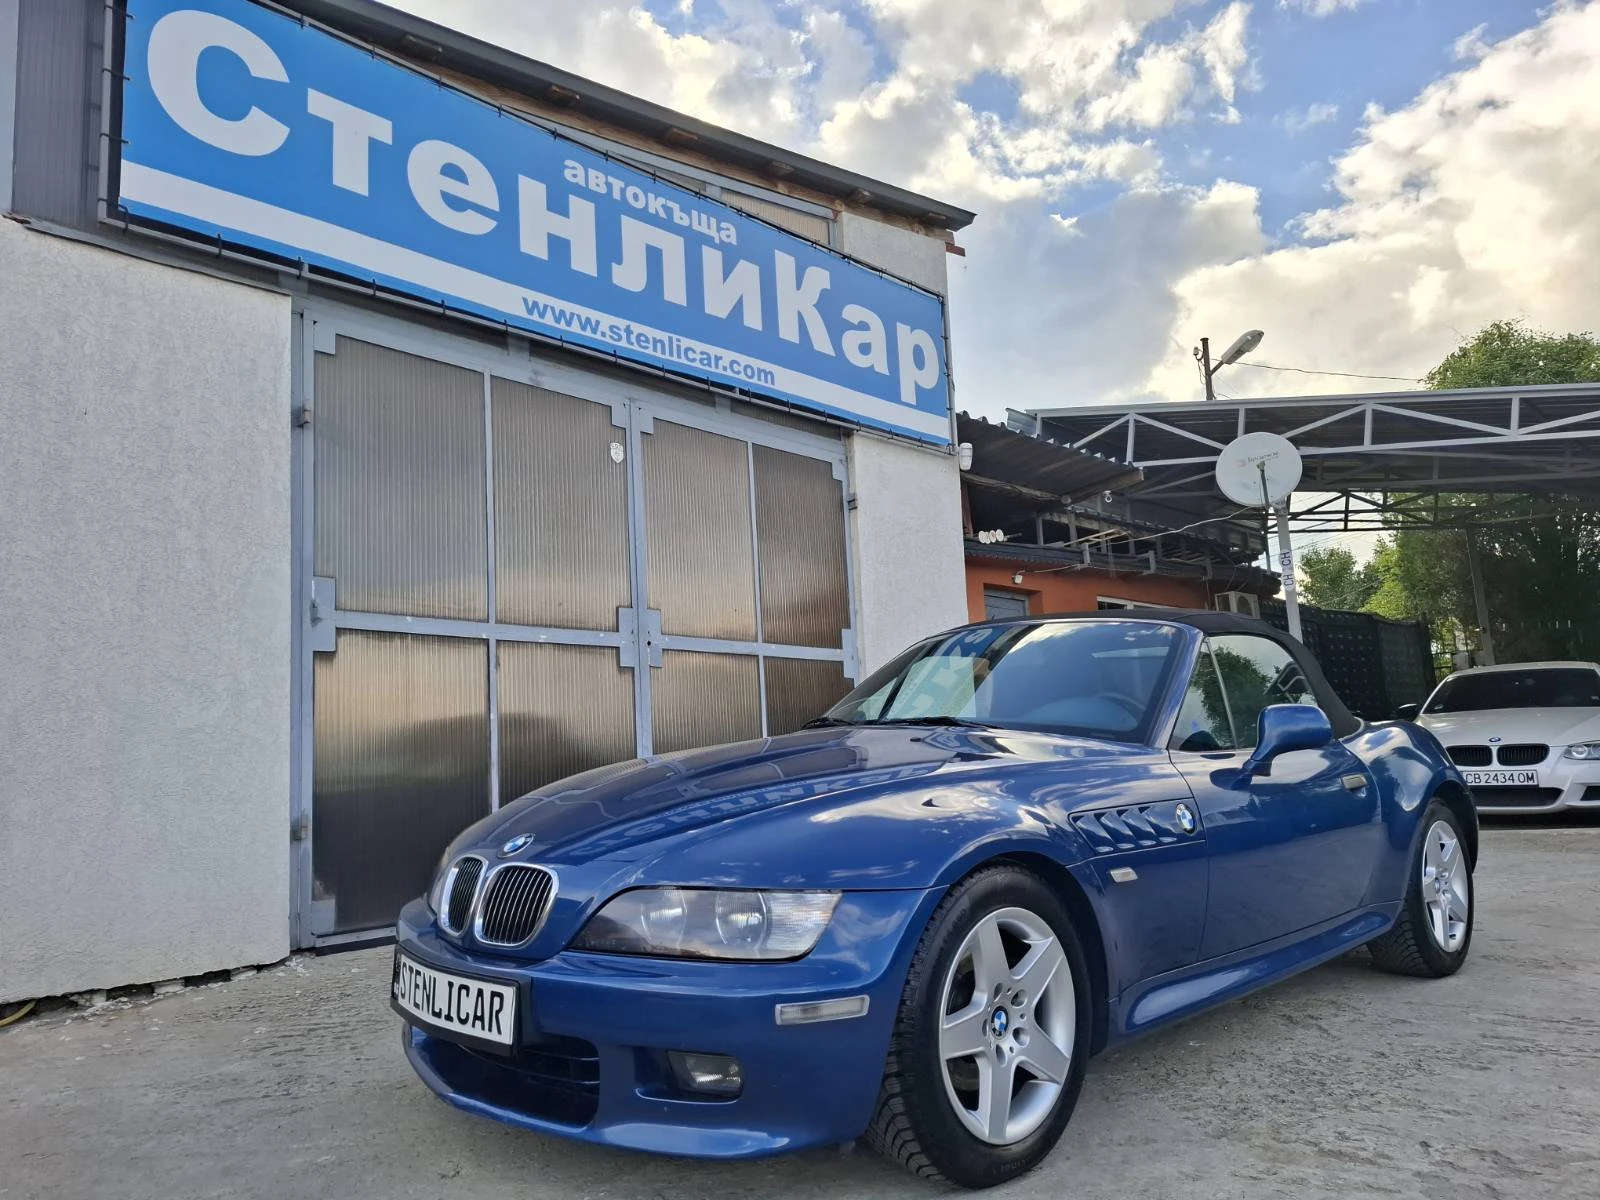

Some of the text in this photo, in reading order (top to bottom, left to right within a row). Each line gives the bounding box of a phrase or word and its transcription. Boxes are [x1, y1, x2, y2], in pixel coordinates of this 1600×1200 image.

[147, 9, 940, 404] СтенлиКар
[563, 159, 737, 245] автокъща
[522, 296, 775, 385] www.stenlicar.com
[1484, 773, 1515, 784] 2434
[400, 961, 505, 1035] STENLICAR
